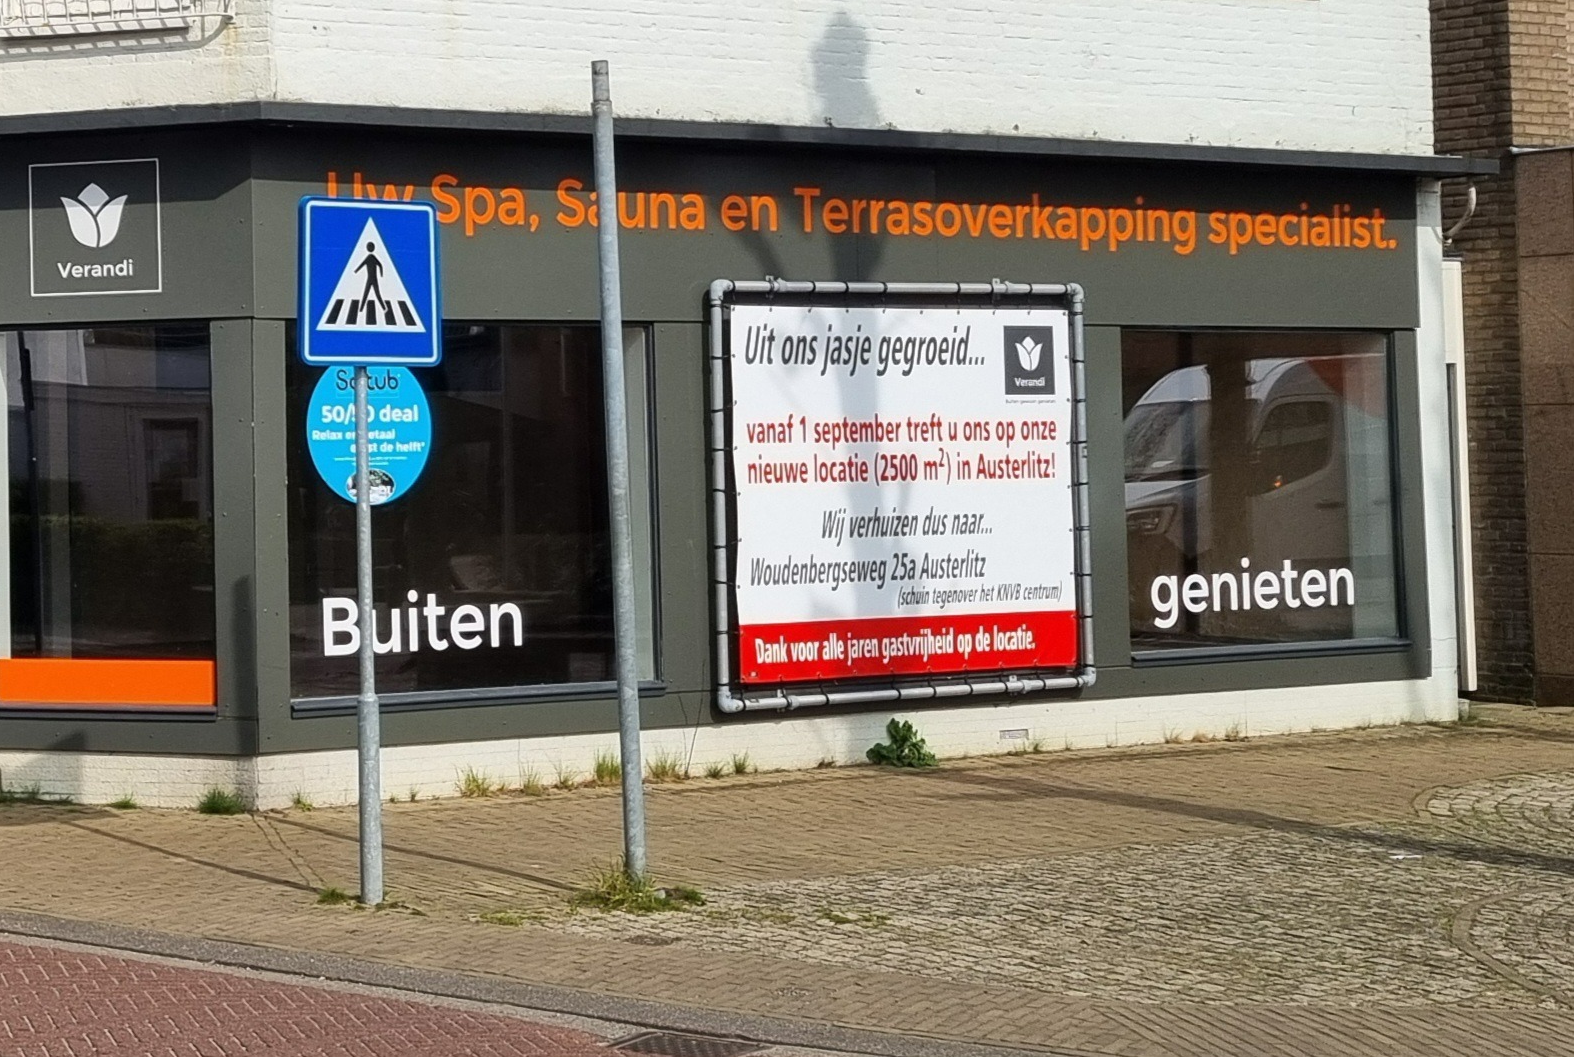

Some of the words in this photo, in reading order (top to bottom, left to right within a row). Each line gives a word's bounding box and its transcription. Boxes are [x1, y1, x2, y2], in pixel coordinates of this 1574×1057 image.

[431, 174, 539, 236] Spa,
[720, 194, 778, 232] en
[793, 187, 1196, 256] Terrasoverkapping
[1208, 201, 1398, 256] specialist.
[57, 258, 134, 279] Verandi
[744, 323, 776, 365] Uit
[781, 337, 818, 365] ons
[820, 324, 872, 377] jasje
[876, 325, 986, 377] gegroeid...
[335, 369, 400, 391] Stub
[321, 403, 375, 425] 50/0
[379, 404, 420, 423] deal
[746, 413, 795, 444] vanaf
[799, 416, 807, 442] 1
[814, 413, 901, 450] september
[906, 413, 943, 442] treft
[948, 420, 958, 442] u
[963, 420, 991, 442] ons
[995, 419, 1016, 448] op
[1020, 420, 1057, 441] onze
[312, 429, 343, 441] Relax
[367, 428, 396, 441] etaal
[349, 443, 379, 454] est
[379, 442, 395, 453] de
[747, 454, 809, 484] nieuwe
[814, 452, 869, 483] locatie
[874, 451, 918, 487] (2500
[957, 451, 972, 481] in
[976, 450, 1057, 480] Austerlitz!
[821, 507, 847, 547] Wij
[849, 507, 918, 540] verhuizen
[922, 506, 948, 537] dus
[951, 512, 993, 536] naar...
[750, 553, 887, 591] Woudenbergseweg
[890, 552, 916, 581] 25a
[919, 548, 987, 580] Austerlitz
[897, 585, 930, 609] (schuin
[932, 586, 977, 609] tegenover
[979, 583, 994, 602] het
[996, 583, 1021, 602] KNVB
[1023, 581, 1063, 603] centrum)
[1150, 557, 1355, 629] genieten
[322, 589, 523, 657] Buiten
[755, 635, 788, 665] Dank
[791, 640, 819, 662] voor
[822, 632, 845, 660] alle
[847, 632, 879, 666] jaren
[882, 627, 954, 665] gastvrijheid
[957, 631, 972, 661] op
[975, 625, 991, 653] de
[993, 624, 1036, 652] locatie.
